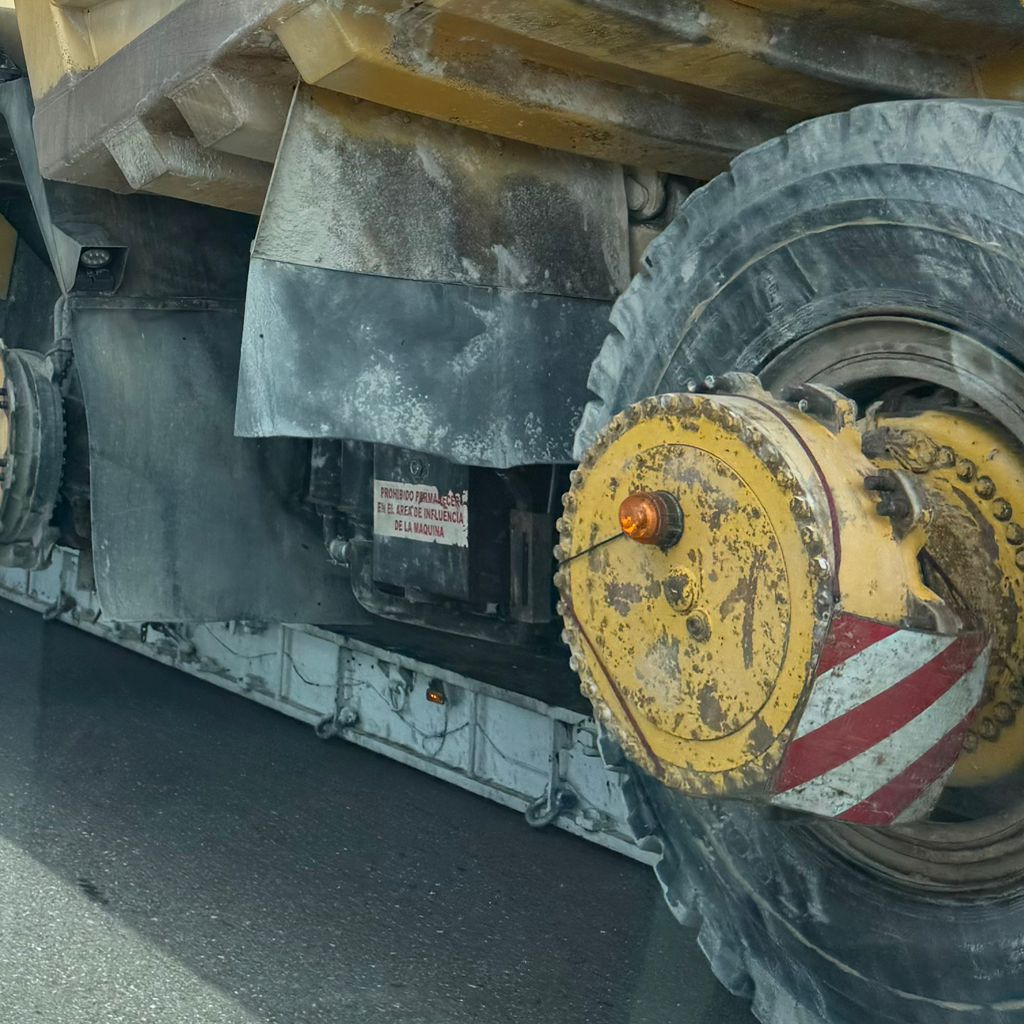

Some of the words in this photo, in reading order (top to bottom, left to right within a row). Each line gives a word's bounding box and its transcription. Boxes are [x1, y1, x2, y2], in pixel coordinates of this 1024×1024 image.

[380, 487, 414, 502] PROHIBIDO
[377, 502, 386, 513] EN
[387, 503, 395, 514] EL
[414, 506, 422, 518] DE
[424, 508, 464, 524] INFLUENCIA
[394, 520, 403, 531] DE
[404, 521, 412, 532] LA
[414, 522, 444, 538] MAQUINA
